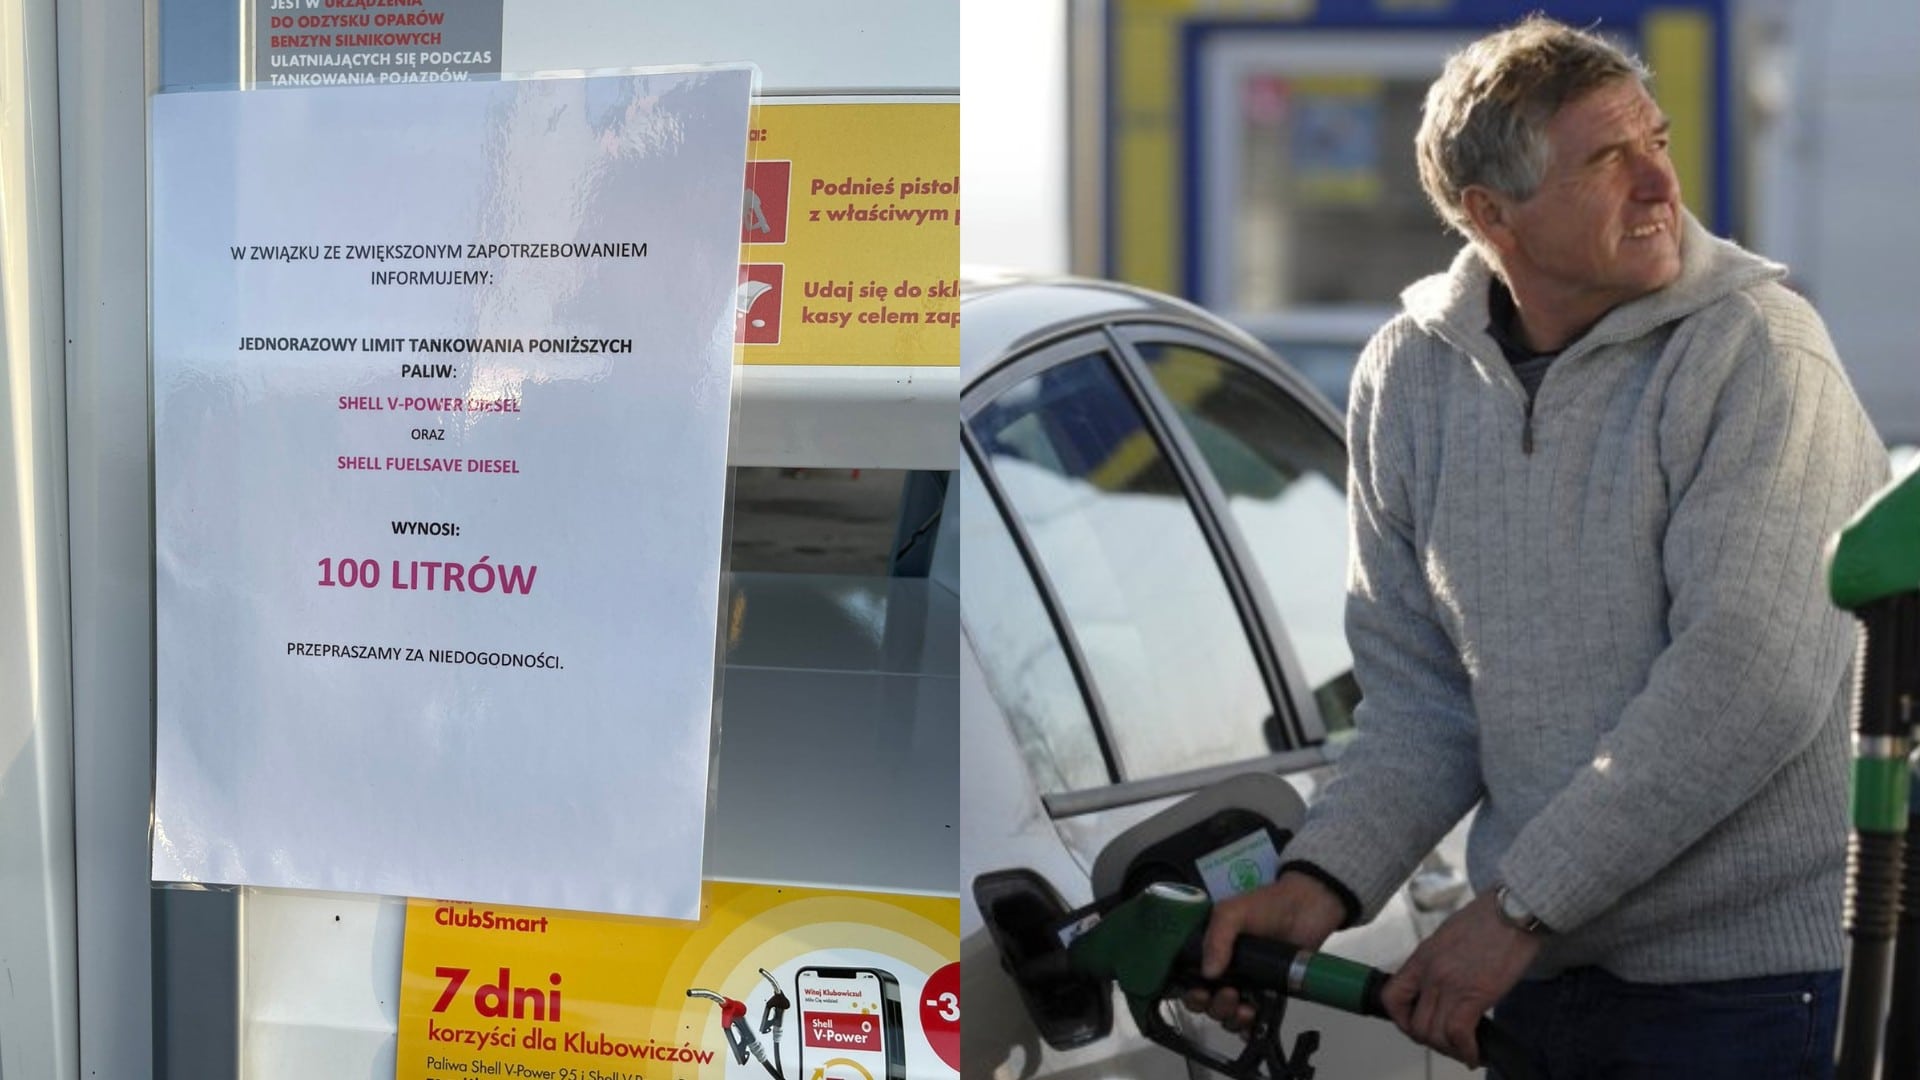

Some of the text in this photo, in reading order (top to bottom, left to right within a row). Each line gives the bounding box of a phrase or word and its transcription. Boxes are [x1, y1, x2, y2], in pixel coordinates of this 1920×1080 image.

[271, 0, 300, 9] JEST
[271, 10, 444, 28] DO ODZYSKU OPARÓW
[271, 32, 441, 48] BENZYN SILNIKOWYCH
[271, 51, 492, 69] ULATNIAJĄCYCH SIĘ PODCZAS
[271, 68, 472, 87] TANKOWANIA POJAZDÓW.
[811, 176, 960, 200] Podnieś pistol
[809, 209, 820, 222] z
[826, 203, 949, 226] właściwym
[230, 242, 648, 263] W ZWIĄZKU ZE ZWIĘKSZONYM ZAPOTRZEBOWANIEM
[371, 270, 494, 286] INFORMUJEMY:
[804, 280, 960, 302] Udaj się do skl
[801, 306, 852, 328] kasy
[858, 306, 919, 324] celem
[238, 335, 633, 354] JEDNORAZOWY LIMIT TANKOWANIA PONIŻSZYCH
[401, 364, 457, 379] PALIW:
[338, 396, 521, 413] SHELL V-POWER DIESEL
[411, 428, 445, 441] ORAZ
[337, 456, 520, 474] SHELL FUELSAVE DIESEL
[391, 521, 461, 537] WYNOSI:
[317, 555, 538, 595] 100 LITRÓW
[287, 642, 565, 670] PRZEPRASZAMY ZA NIEDOGODNOŚCI.
[434, 906, 549, 933] ClubSmart
[432, 966, 562, 1023] 7 dni
[812, 1018, 833, 1028] Shell
[428, 1019, 714, 1065] korzyści dla Klubowiczów
[813, 1028, 869, 1044] V-Power
[427, 1056, 467, 1072] Paliwa
[471, 1060, 501, 1075] Shell
[504, 1063, 556, 1079] V-Power
[559, 1068, 577, 1080] 95
